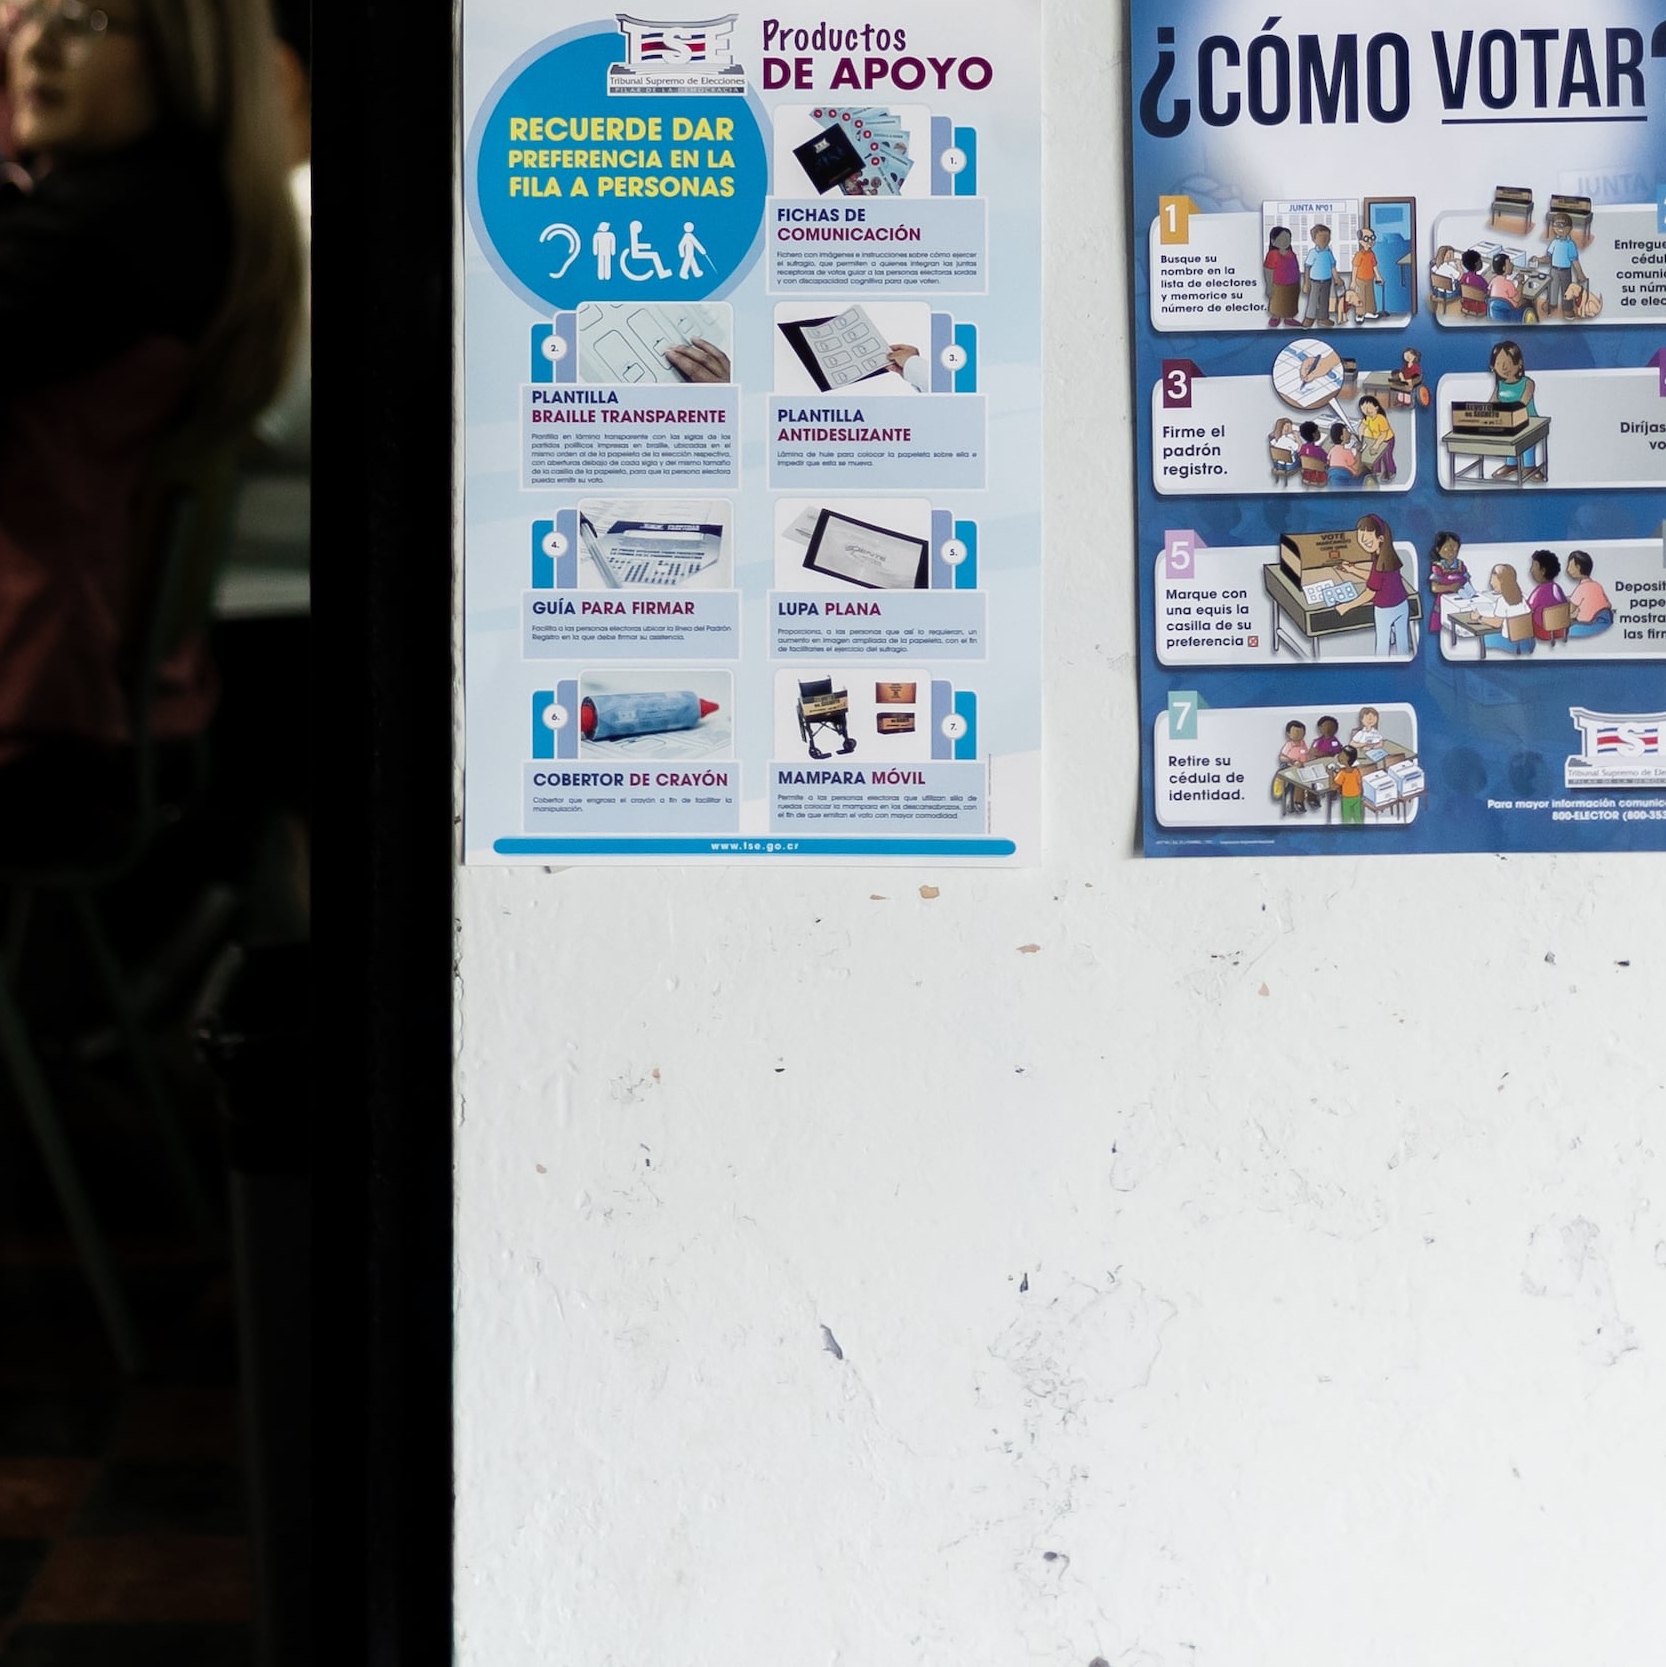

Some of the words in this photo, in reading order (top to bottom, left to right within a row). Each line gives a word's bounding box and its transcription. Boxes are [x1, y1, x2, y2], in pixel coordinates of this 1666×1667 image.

[763, 19, 906, 51] Productos
[763, 58, 813, 89] DE
[830, 57, 992, 90] APOYO
[1140, 16, 1409, 138] ¿CÓMO
[610, 77, 643, 85] Tribunal
[646, 77, 684, 86] Supremo
[687, 77, 698, 85] de
[701, 77, 745, 85] Elecciones
[510, 119, 663, 141] RECUERDE
[672, 118, 734, 141] DAR
[509, 151, 661, 169] PREFERENCIA
[671, 151, 700, 169] EN
[707, 151, 736, 169] LA
[510, 178, 562, 198] FILA
[570, 178, 590, 197] A
[598, 177, 735, 198] PERSONAS
[778, 209, 839, 221] FICHAS
[846, 209, 865, 221] DE
[1165, 204, 1177, 233] 1
[778, 224, 920, 241] COMUNICACIÓN
[1161, 255, 1201, 264] Busque
[1161, 267, 1203, 275] nombre
[1161, 280, 1183, 288] lista
[1206, 279, 1257, 287] electores
[1161, 294, 1167, 302] y
[1171, 292, 1227, 300] memorice
[1621, 297, 1636, 306] de
[1161, 301, 1202, 312] número
[1207, 303, 1221, 312] de
[1226, 302, 1267, 312] elector.
[1167, 370, 1188, 400] 3
[533, 391, 618, 405] PLANTILLA
[532, 410, 597, 423] BRAILLE
[602, 410, 725, 423] TRANSPARENTE
[777, 409, 864, 422] PLANTILLA
[778, 427, 910, 441] ANTIDESLIZANTE
[1163, 426, 1205, 438] Firme
[1211, 425, 1224, 437] el
[1164, 443, 1220, 459] padrón
[1164, 463, 1227, 478] registro.
[1170, 542, 1191, 570] 5
[1167, 590, 1217, 601] Marque
[533, 598, 575, 614] GUÍA
[582, 602, 626, 614] PARA
[633, 602, 694, 614] FIRMAR
[779, 603, 819, 615] LUPA
[826, 603, 881, 615] PLANA
[1167, 607, 1191, 615] una
[1196, 604, 1232, 617] equis
[1237, 604, 1249, 614] la
[1167, 621, 1210, 631] casilla
[1216, 620, 1232, 630] de
[1237, 622, 1251, 630] su
[1624, 629, 1643, 639] las
[1166, 636, 1244, 648] preferencia
[1171, 702, 1192, 731] 7
[1169, 756, 1210, 766] Retire
[1215, 758, 1230, 766] su
[534, 773, 623, 786] COBERTOR
[630, 773, 649, 786] DE
[656, 770, 727, 786] CRAYÓN
[779, 771, 865, 784] MAMPARA
[872, 768, 925, 784] MÓVIL
[1170, 772, 1220, 783] cédula
[1226, 772, 1244, 783] de
[1170, 789, 1244, 801] identidad.
[1488, 800, 1512, 809] Para
[1515, 800, 1549, 811] mayor
[1552, 799, 1616, 808] información
[1552, 810, 1619, 820] 800-ELECTOR
[711, 842, 799, 852] www.tse.go.cr
